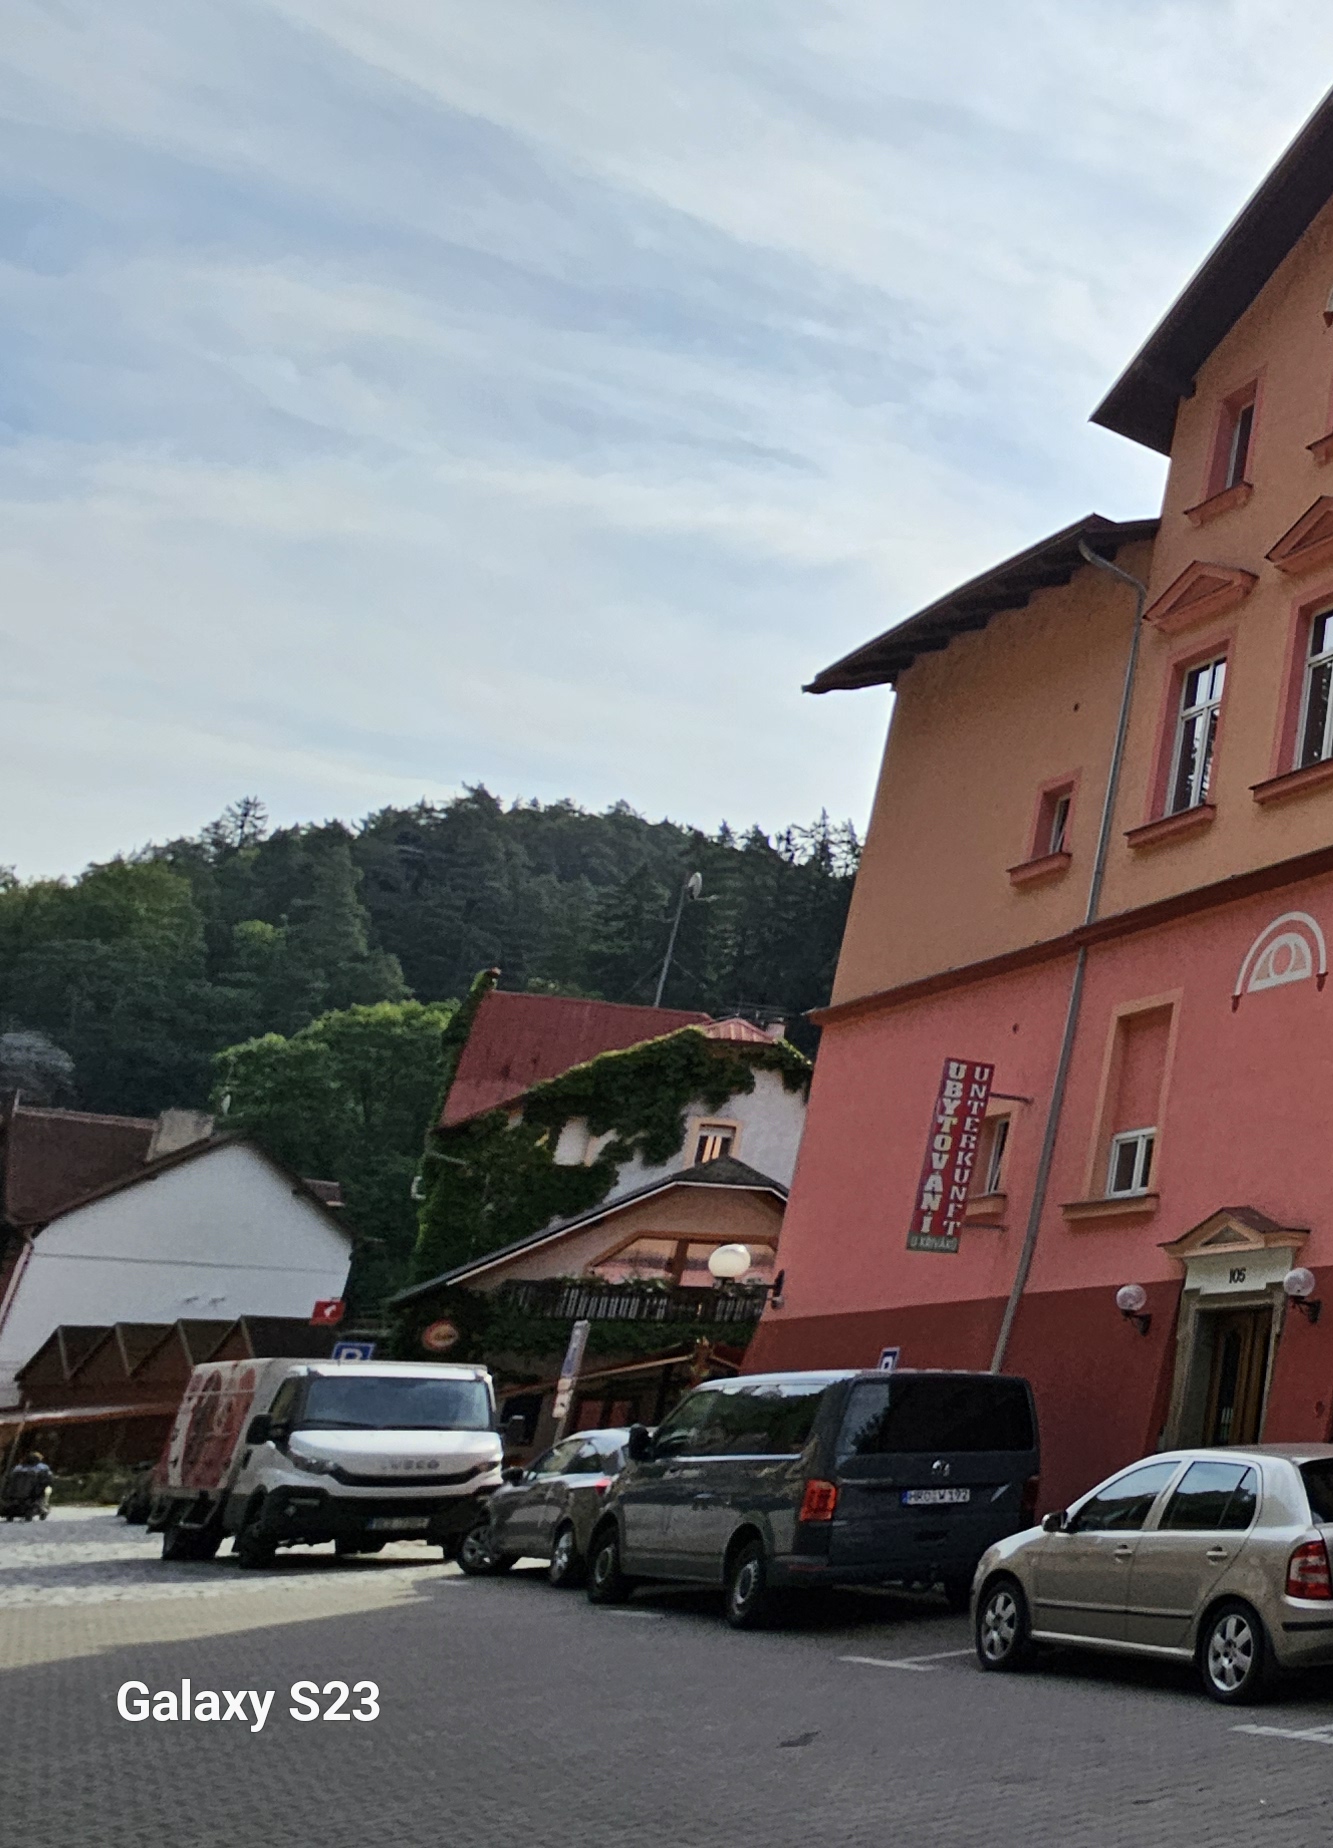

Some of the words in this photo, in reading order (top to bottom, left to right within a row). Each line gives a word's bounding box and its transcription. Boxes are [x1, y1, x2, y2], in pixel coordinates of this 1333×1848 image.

[920, 1061, 967, 1233] UBYTOVÁNÍ
[943, 1066, 990, 1236] UNTERKUNFT
[1229, 1267, 1246, 1284] 105
[381, 1459, 440, 1470] VECO
